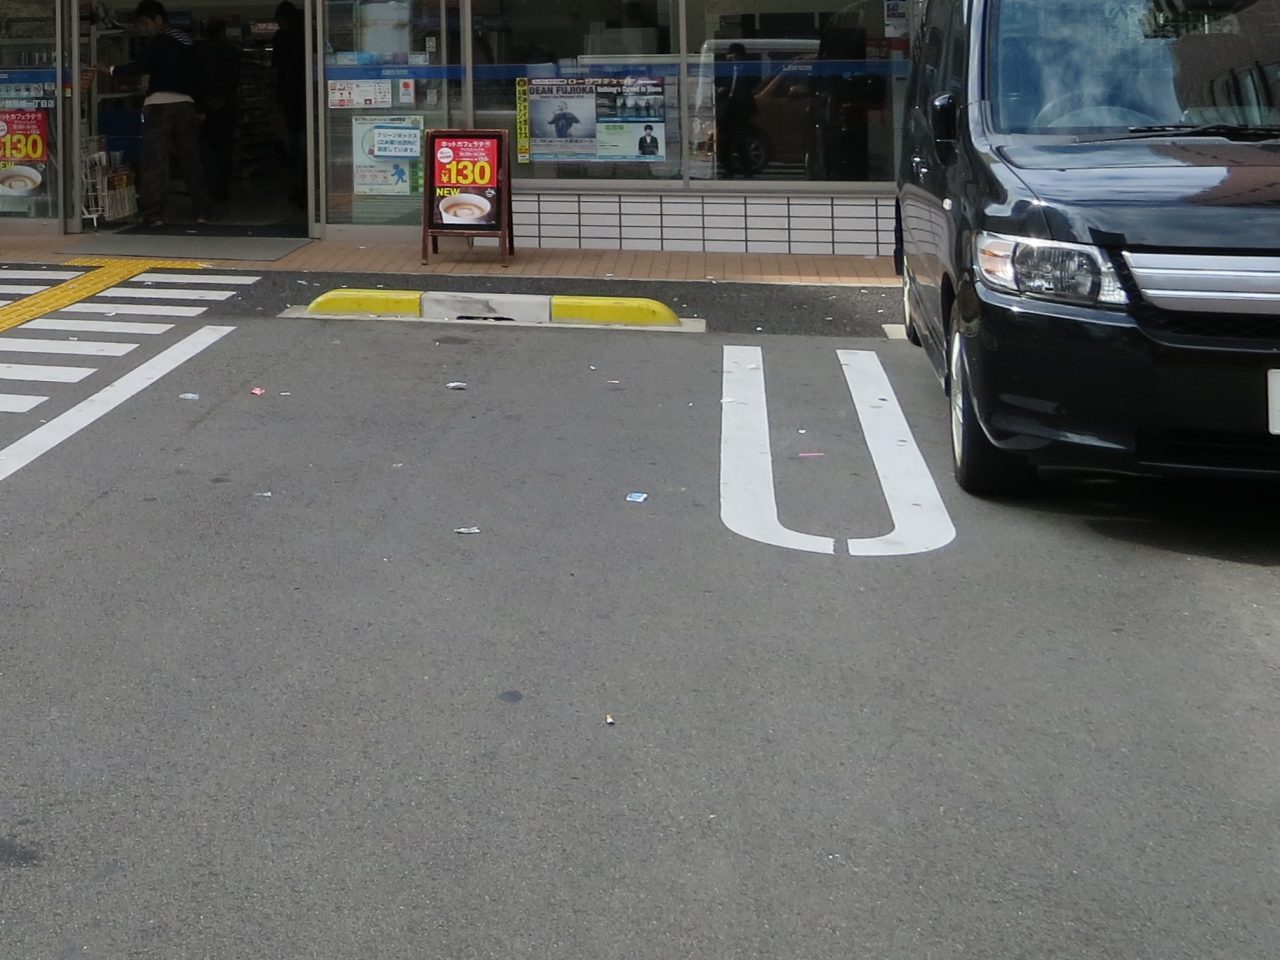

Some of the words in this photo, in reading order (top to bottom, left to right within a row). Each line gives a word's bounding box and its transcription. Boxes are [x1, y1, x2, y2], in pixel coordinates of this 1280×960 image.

[529, 86, 555, 95] DEAN
[556, 86, 595, 95] FUJIOKA
[440, 161, 491, 185] ¥130
[436, 188, 461, 197] NEW
